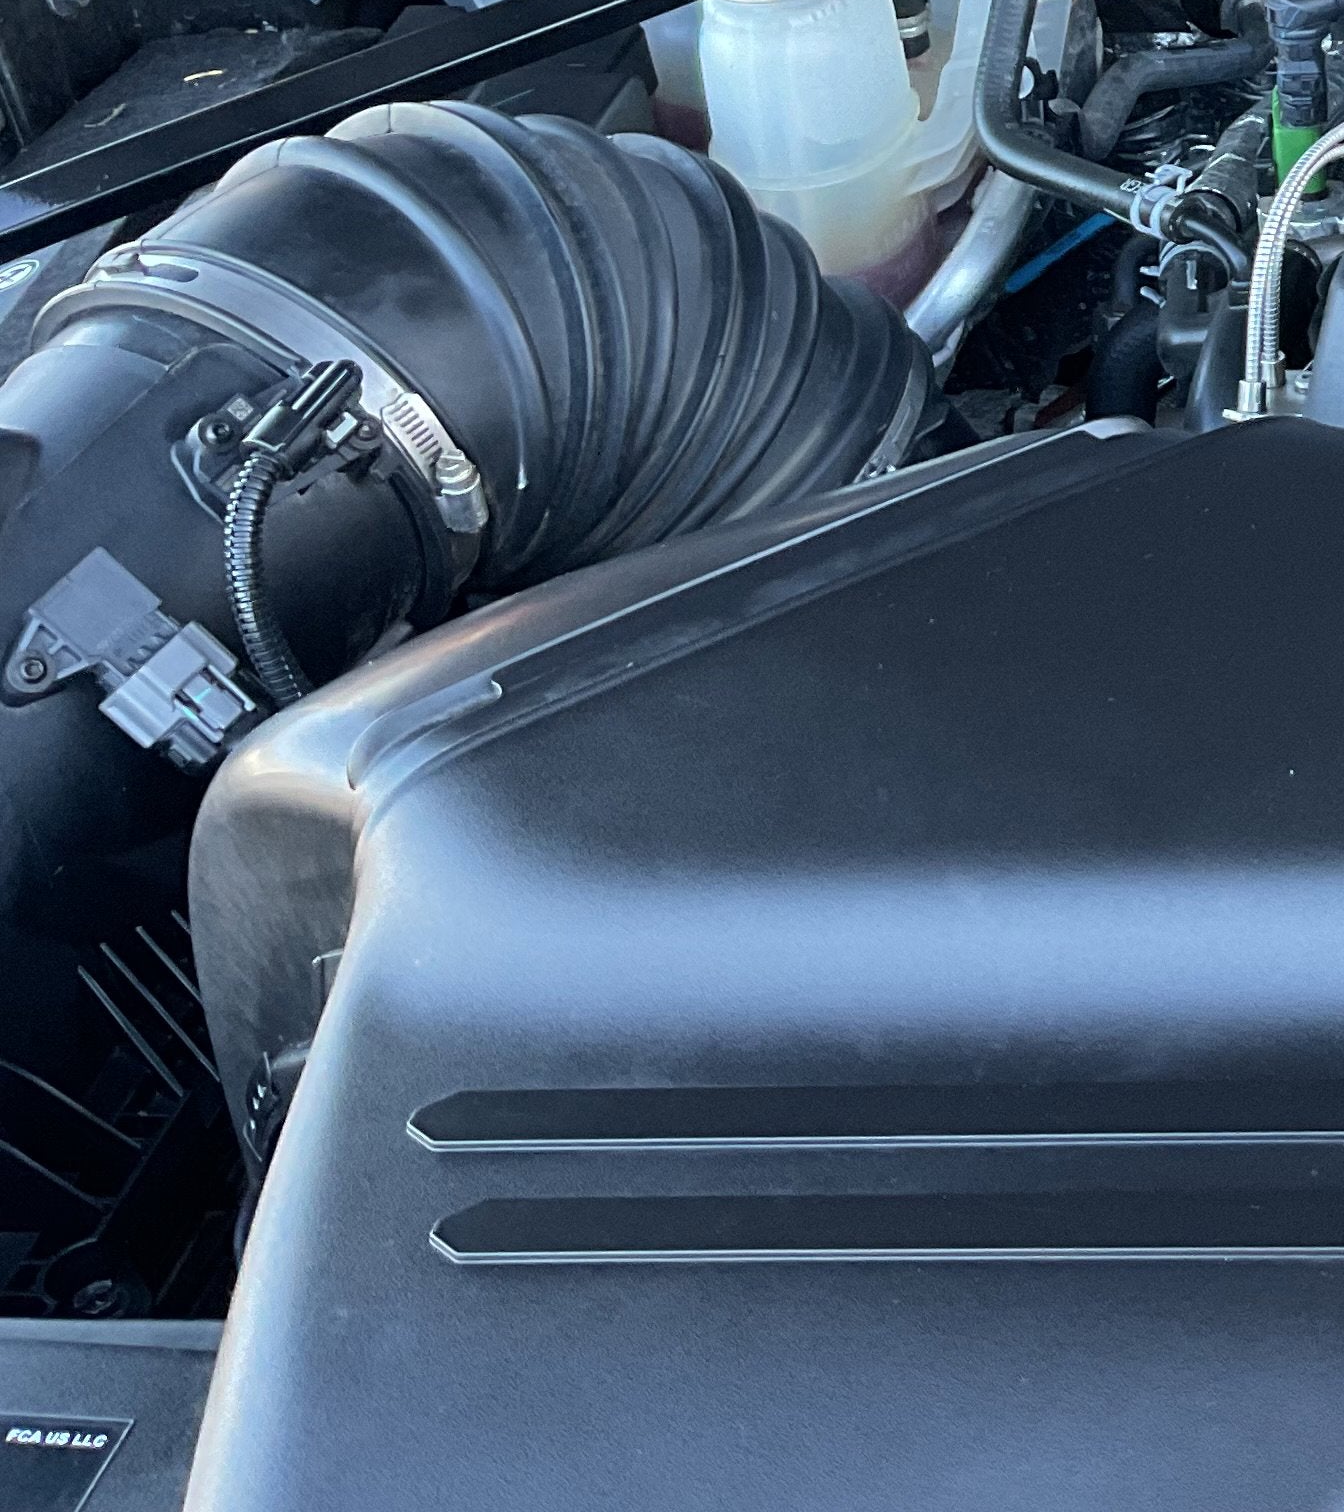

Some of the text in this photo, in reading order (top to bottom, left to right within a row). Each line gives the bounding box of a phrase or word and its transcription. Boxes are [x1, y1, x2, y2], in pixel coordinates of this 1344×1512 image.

[5, 1427, 108, 1449] FCA US LLC
